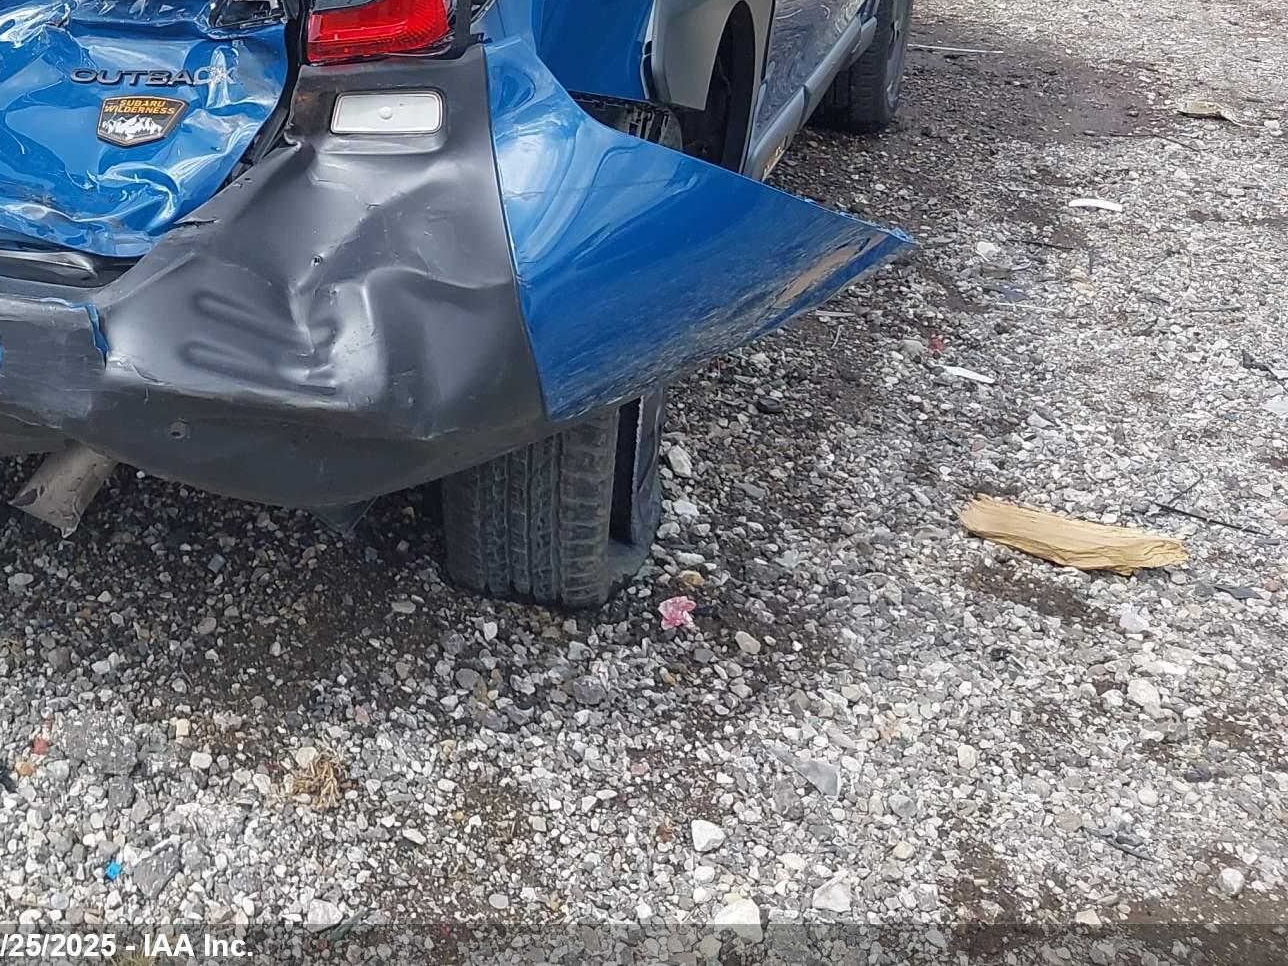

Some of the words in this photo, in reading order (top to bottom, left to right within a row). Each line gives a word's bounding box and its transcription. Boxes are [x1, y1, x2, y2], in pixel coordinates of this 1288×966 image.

[70, 67, 239, 87] OUTBACK
[119, 99, 166, 108] SUBARU
[103, 105, 177, 115] WILDERNESS
